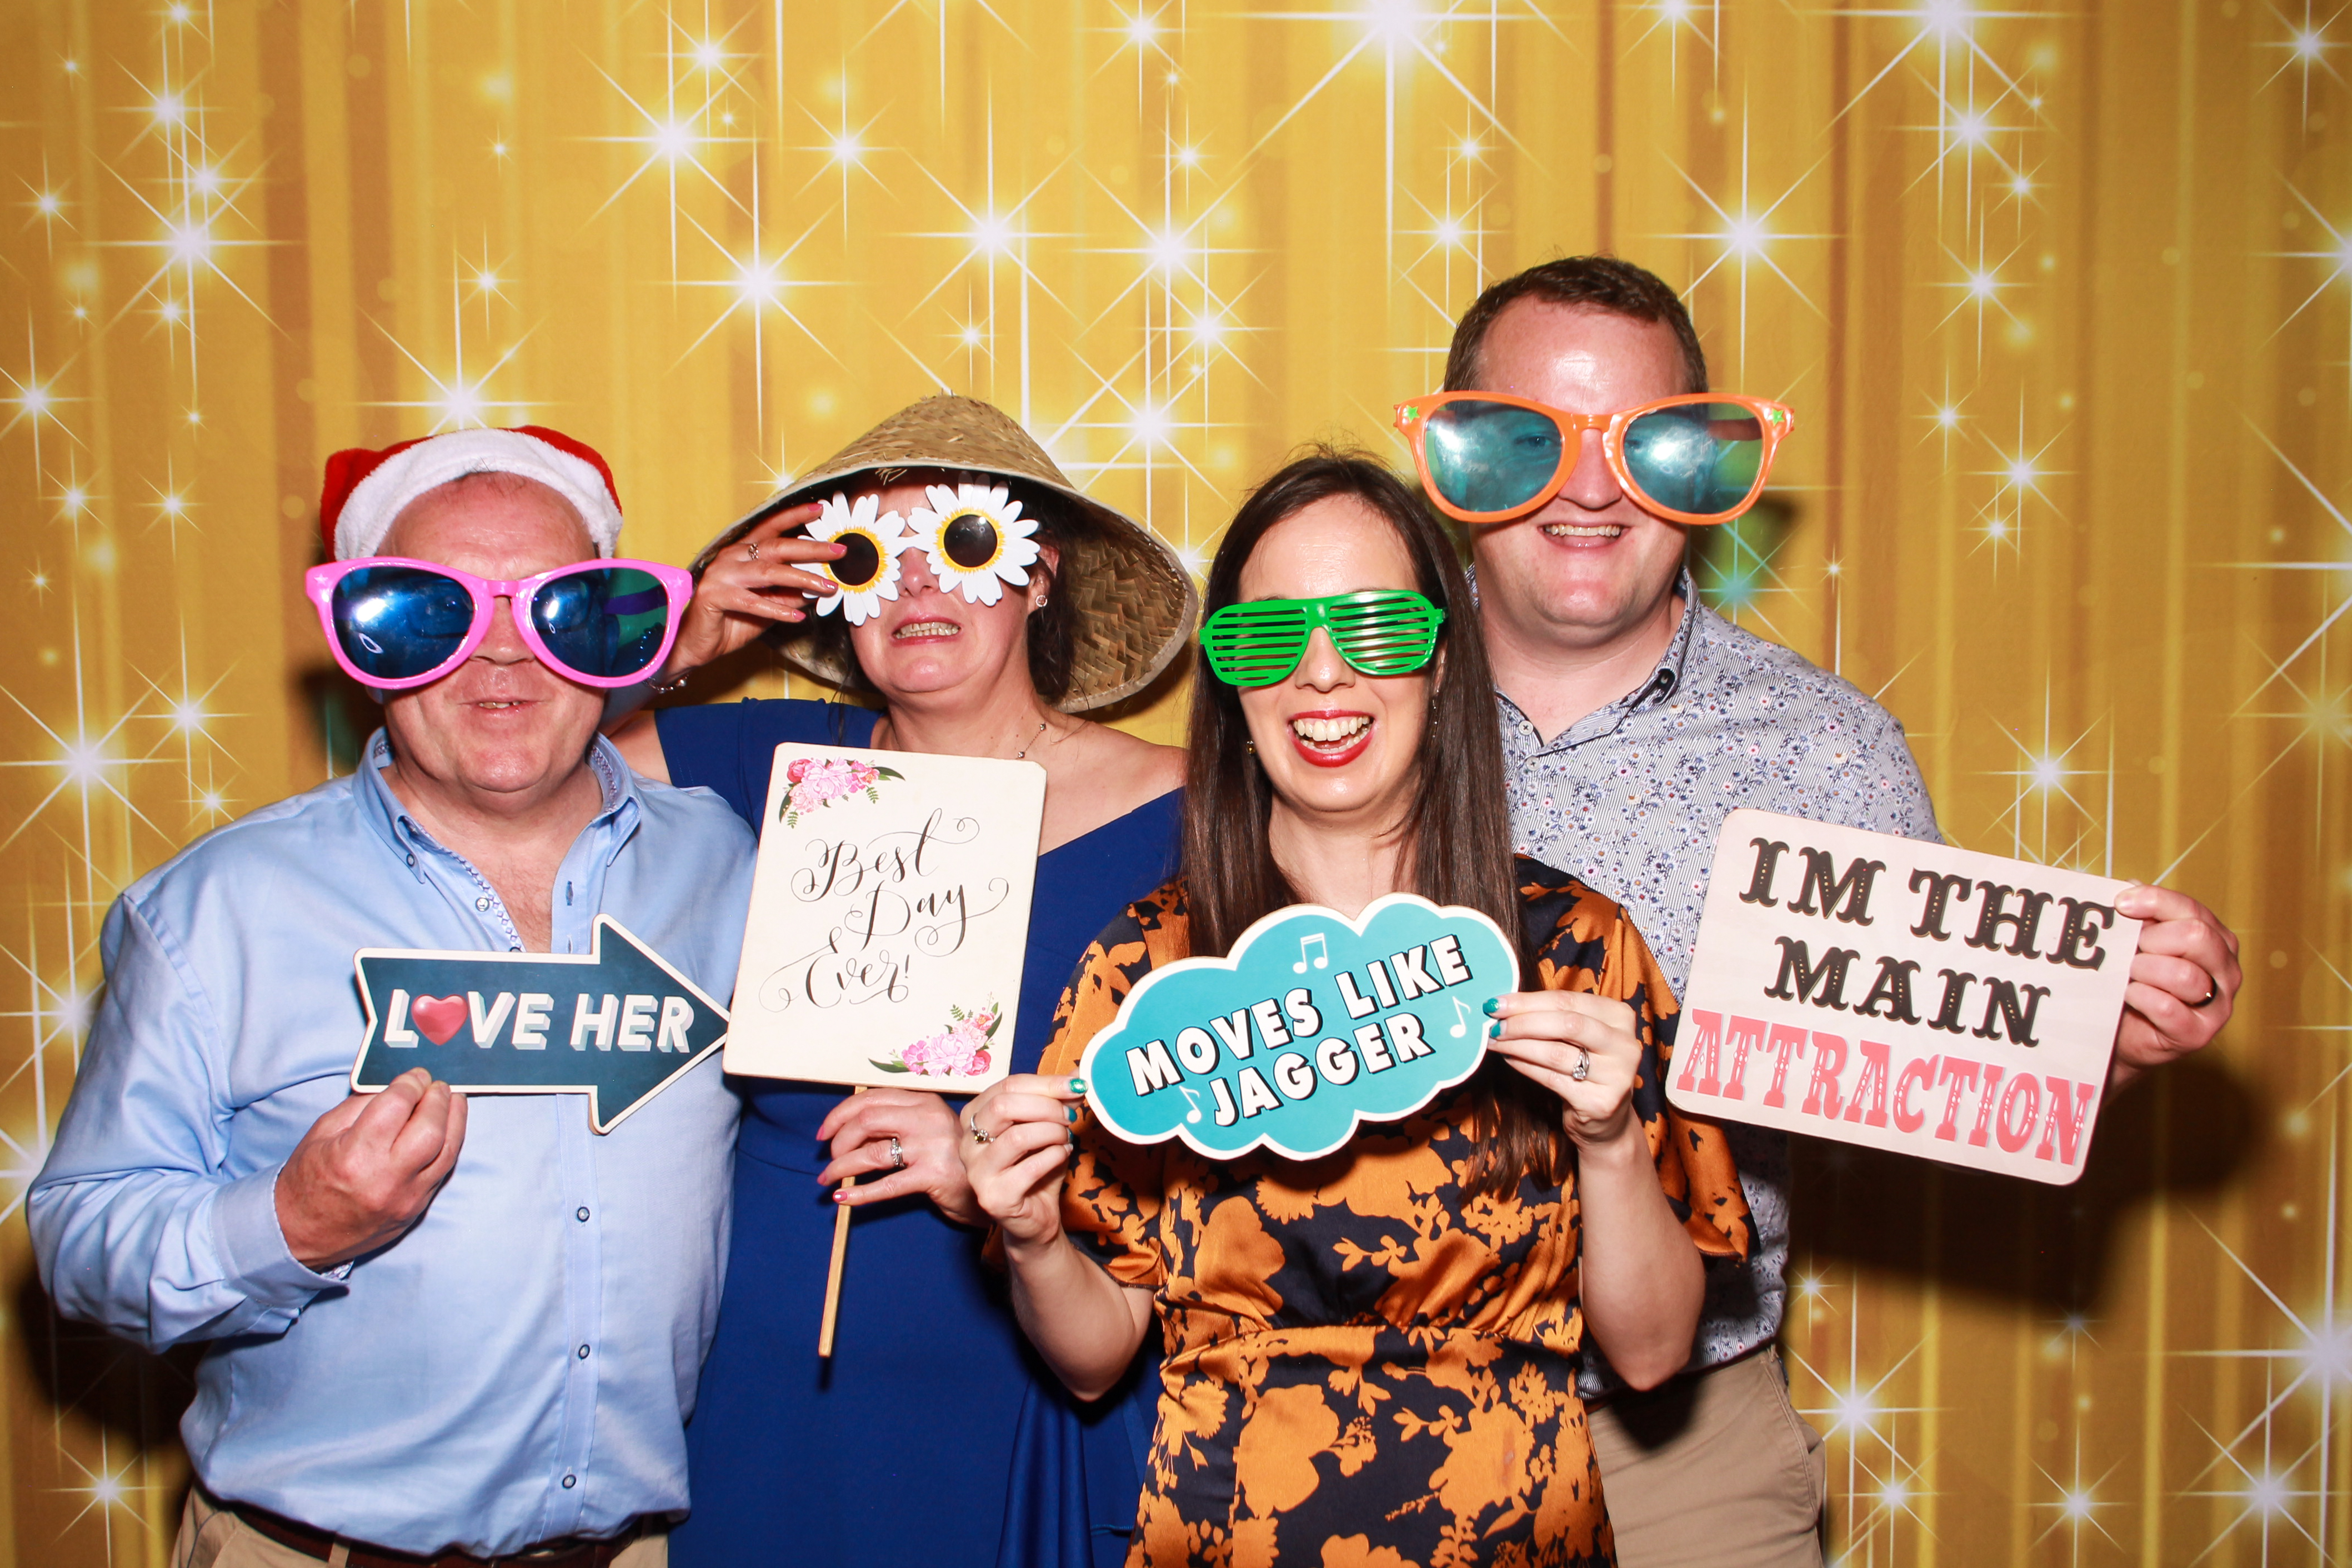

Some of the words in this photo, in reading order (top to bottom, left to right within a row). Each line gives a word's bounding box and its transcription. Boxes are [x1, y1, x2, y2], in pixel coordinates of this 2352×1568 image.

[791, 808, 980, 902] Best
[1739, 837, 1886, 926] IM
[1909, 867, 2115, 971] THE
[759, 926, 909, 1013] Ever!
[844, 878, 1009, 957] Day
[569, 993, 695, 1053] HER
[1125, 988, 1323, 1096] MOVES
[1334, 934, 1473, 1020] LIKE
[1764, 936, 2051, 1048] MAIN
[1209, 1012, 1436, 1127] JAGGER
[1677, 1008, 2098, 1166] ATTRACTION
